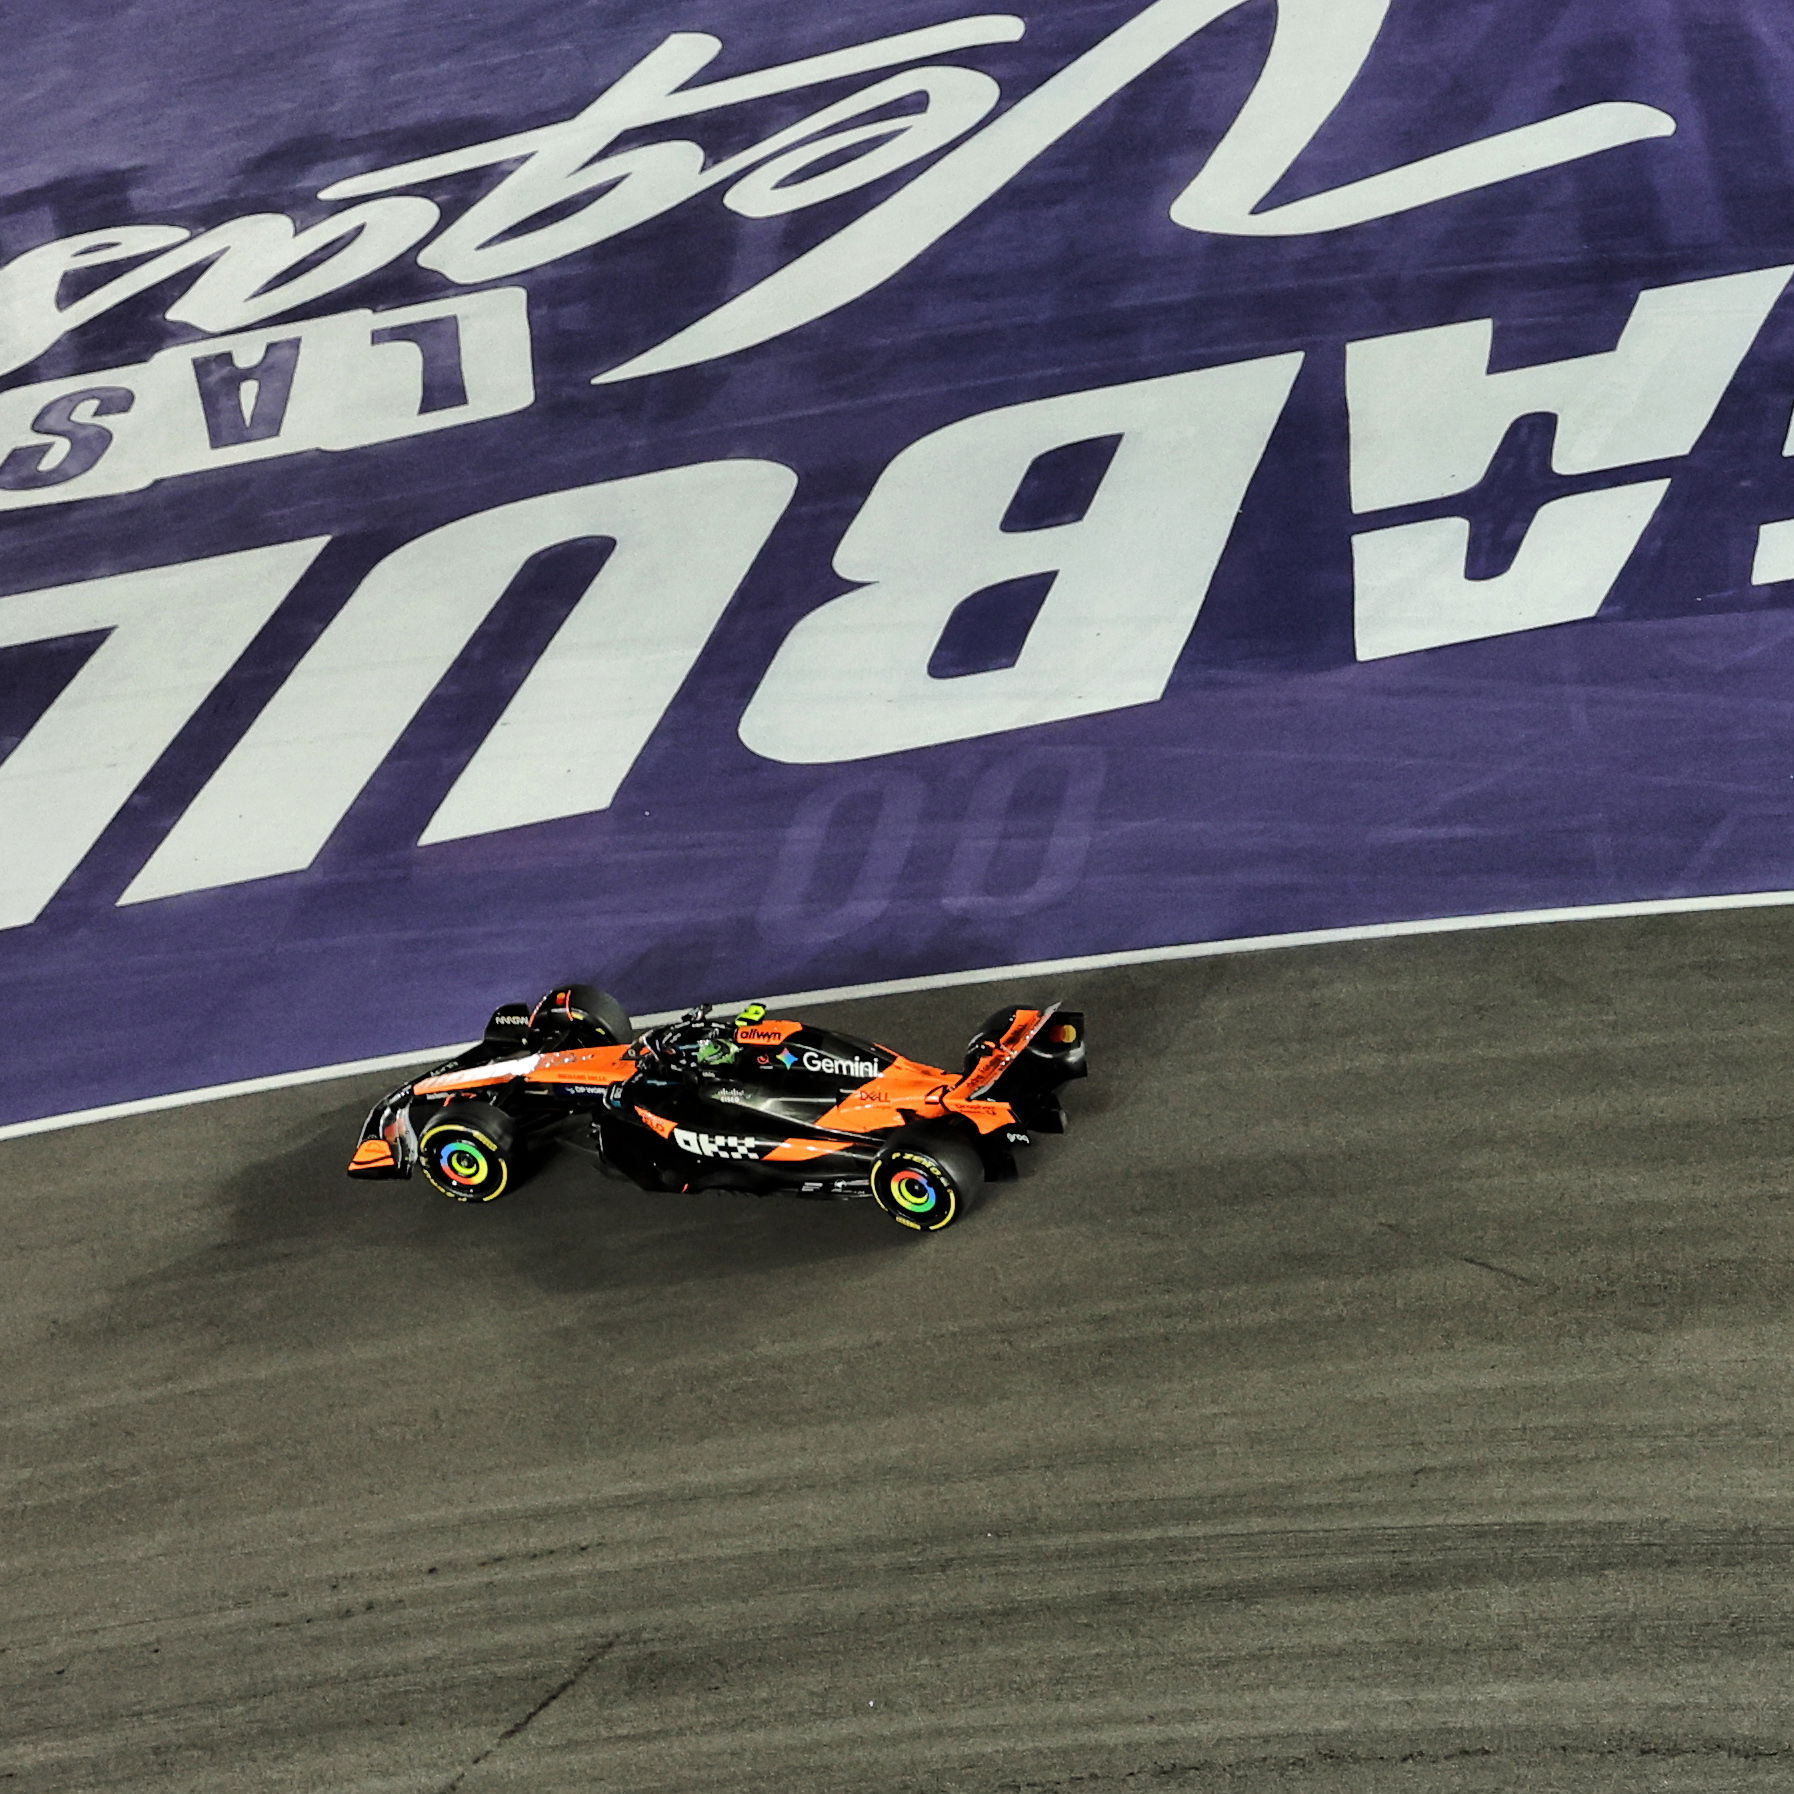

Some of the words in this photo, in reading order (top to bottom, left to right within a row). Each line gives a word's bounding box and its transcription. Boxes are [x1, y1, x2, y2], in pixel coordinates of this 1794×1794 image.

[0, 0, 1676, 383] Vegas
[0, 314, 469, 490] LAS
[740, 1028, 782, 1041] allwyn
[802, 1051, 880, 1078] Gemini
